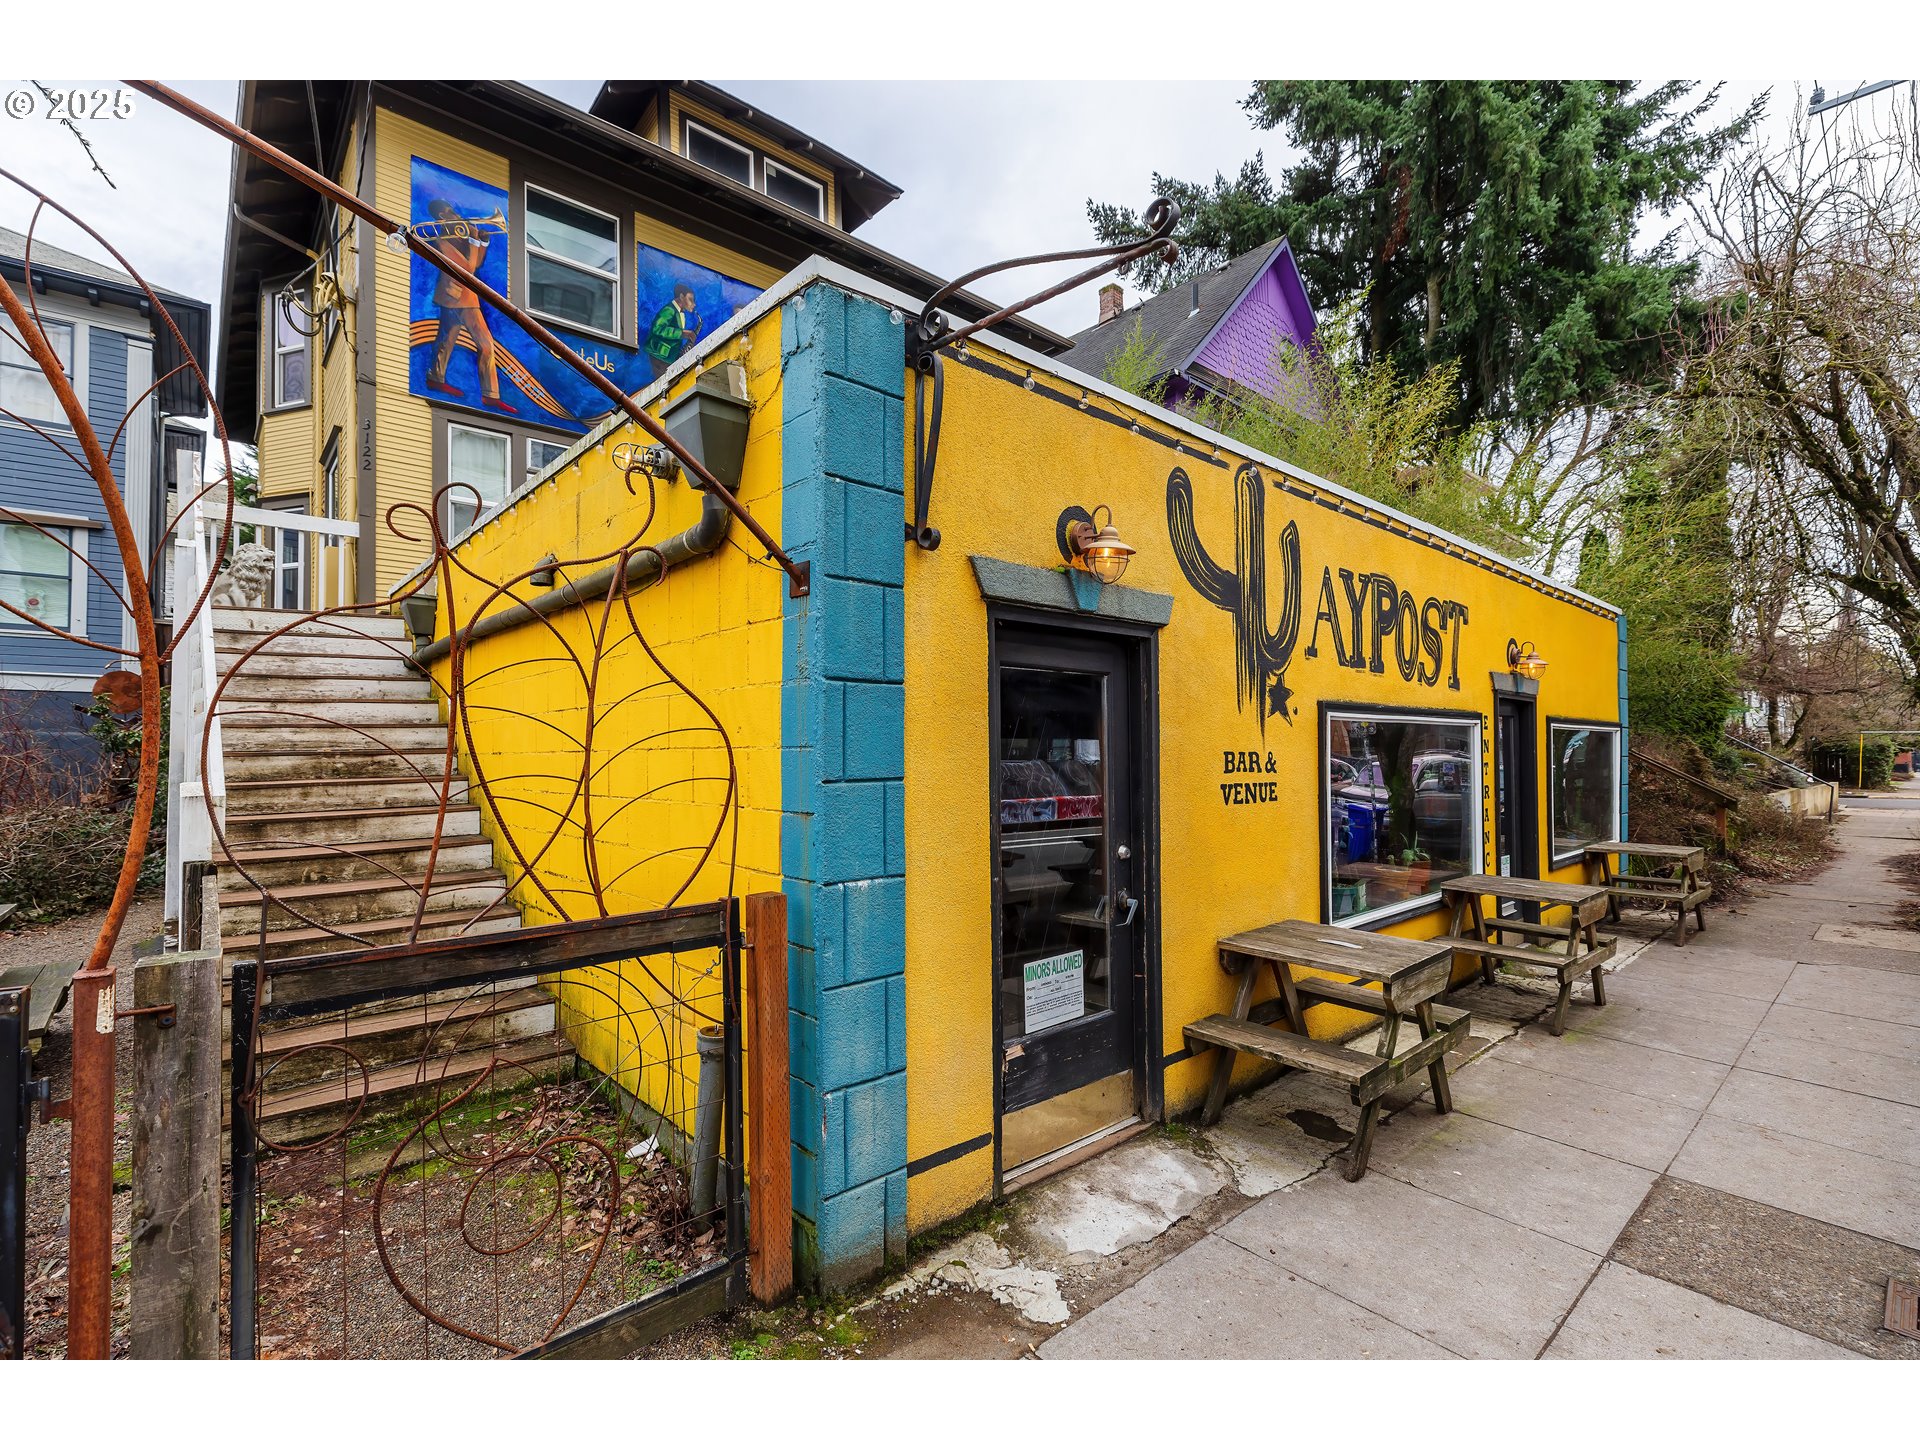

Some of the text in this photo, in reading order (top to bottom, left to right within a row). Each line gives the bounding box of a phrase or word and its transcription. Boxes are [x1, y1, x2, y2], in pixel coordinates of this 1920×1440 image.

[362, 418, 372, 471] 3122
[1223, 750, 1278, 774] BAR &
[1220, 781, 1278, 806] VENUE
[1483, 715, 1491, 868] ENTRANC
[1025, 954, 1082, 982] MINORS ALLOWED
